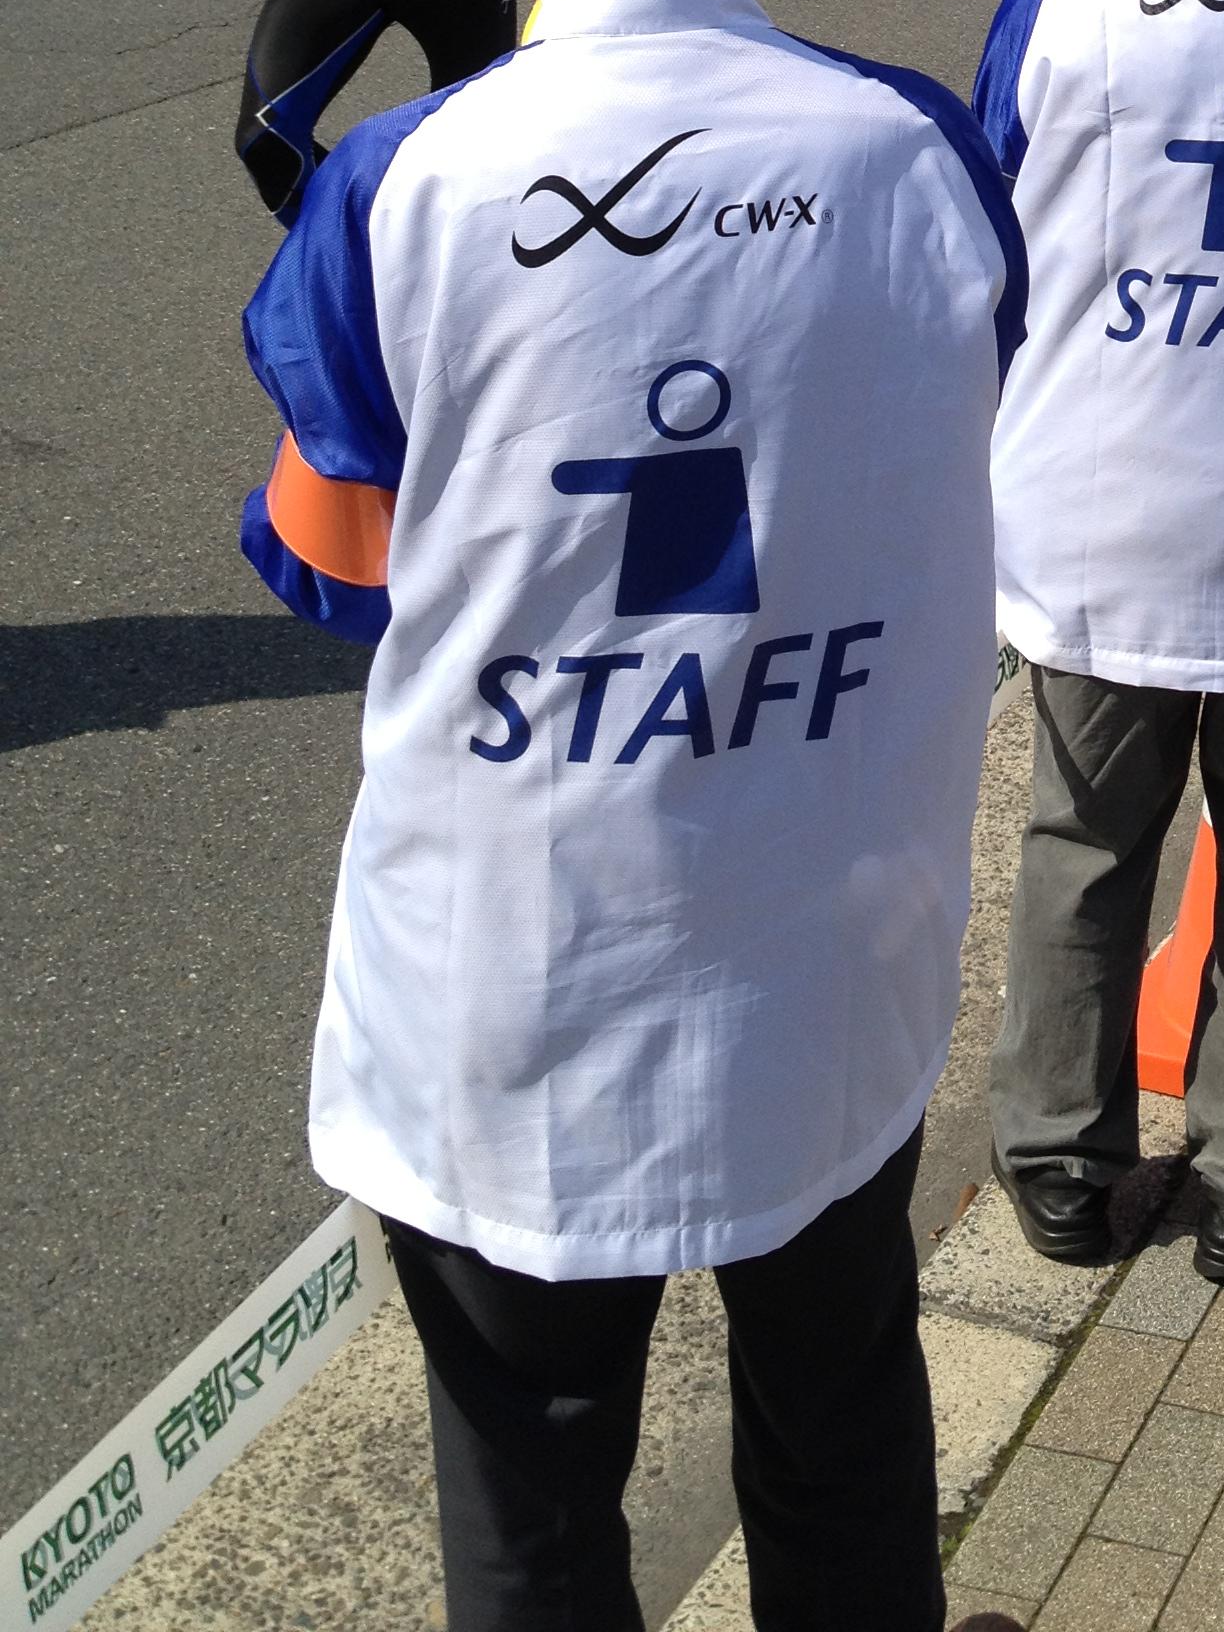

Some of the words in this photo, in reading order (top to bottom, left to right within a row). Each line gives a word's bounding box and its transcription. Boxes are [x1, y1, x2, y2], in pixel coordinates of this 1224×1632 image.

[469, 620, 884, 764] STAFF
[154, 1236, 363, 1482] 京都マラソン
[20, 1453, 136, 1593] KYOTO
[27, 1493, 144, 1623] MARATHON
